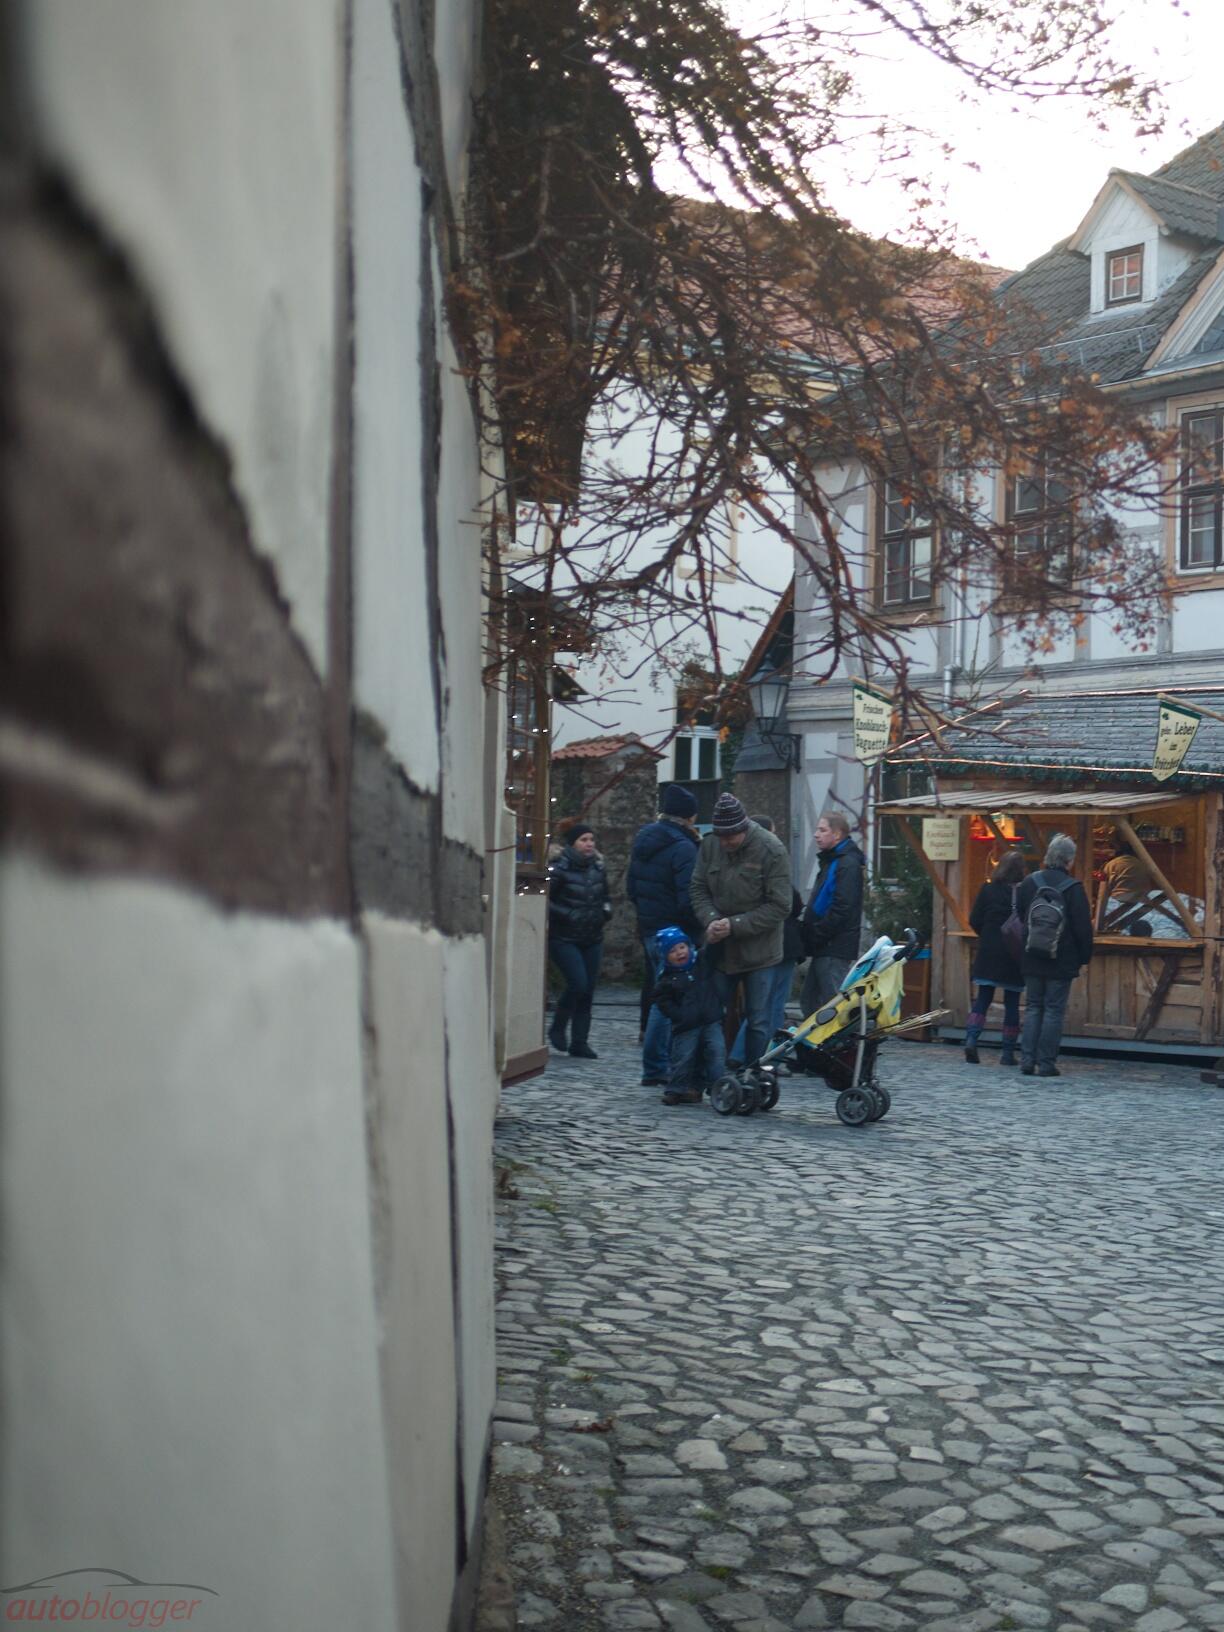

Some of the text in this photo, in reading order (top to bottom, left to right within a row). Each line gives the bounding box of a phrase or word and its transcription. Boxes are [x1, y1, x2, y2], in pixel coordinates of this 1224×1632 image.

[856, 718, 888, 732] Knoblauch-
[1174, 721, 1195, 735] Leber
[856, 733, 886, 753] Baguette
